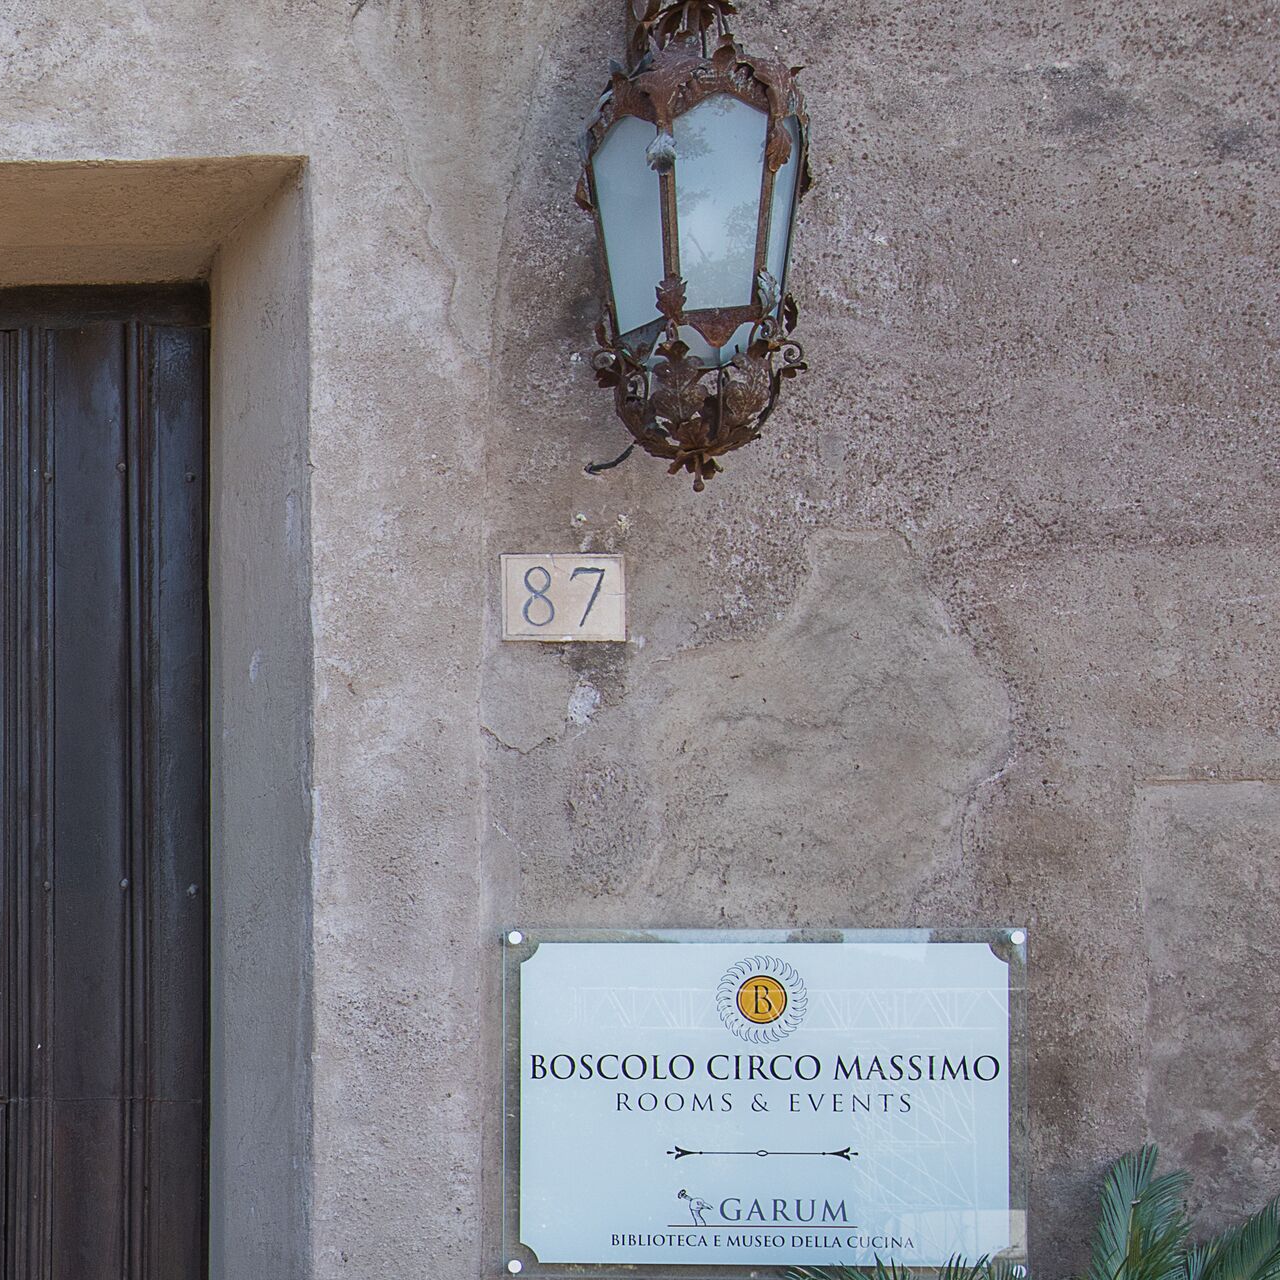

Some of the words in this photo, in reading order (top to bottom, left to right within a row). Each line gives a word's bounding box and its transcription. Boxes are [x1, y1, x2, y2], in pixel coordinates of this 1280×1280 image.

[522, 566, 605, 627] 87
[754, 985, 772, 1014] B
[530, 1053, 695, 1081] BOSCOLO
[706, 1054, 821, 1081] CIRCO
[833, 1054, 1000, 1082] MASSIMO
[616, 1091, 733, 1112] ROOMS
[751, 1092, 770, 1112] &
[789, 1092, 912, 1113] EVENTS
[719, 1197, 849, 1222] GARUM
[611, 1233, 708, 1247] BIBLIOTECA
[713, 1234, 721, 1247] E
[726, 1234, 786, 1248] MUSEO
[791, 1235, 842, 1248] DELLA
[846, 1235, 915, 1249] CUCINA
